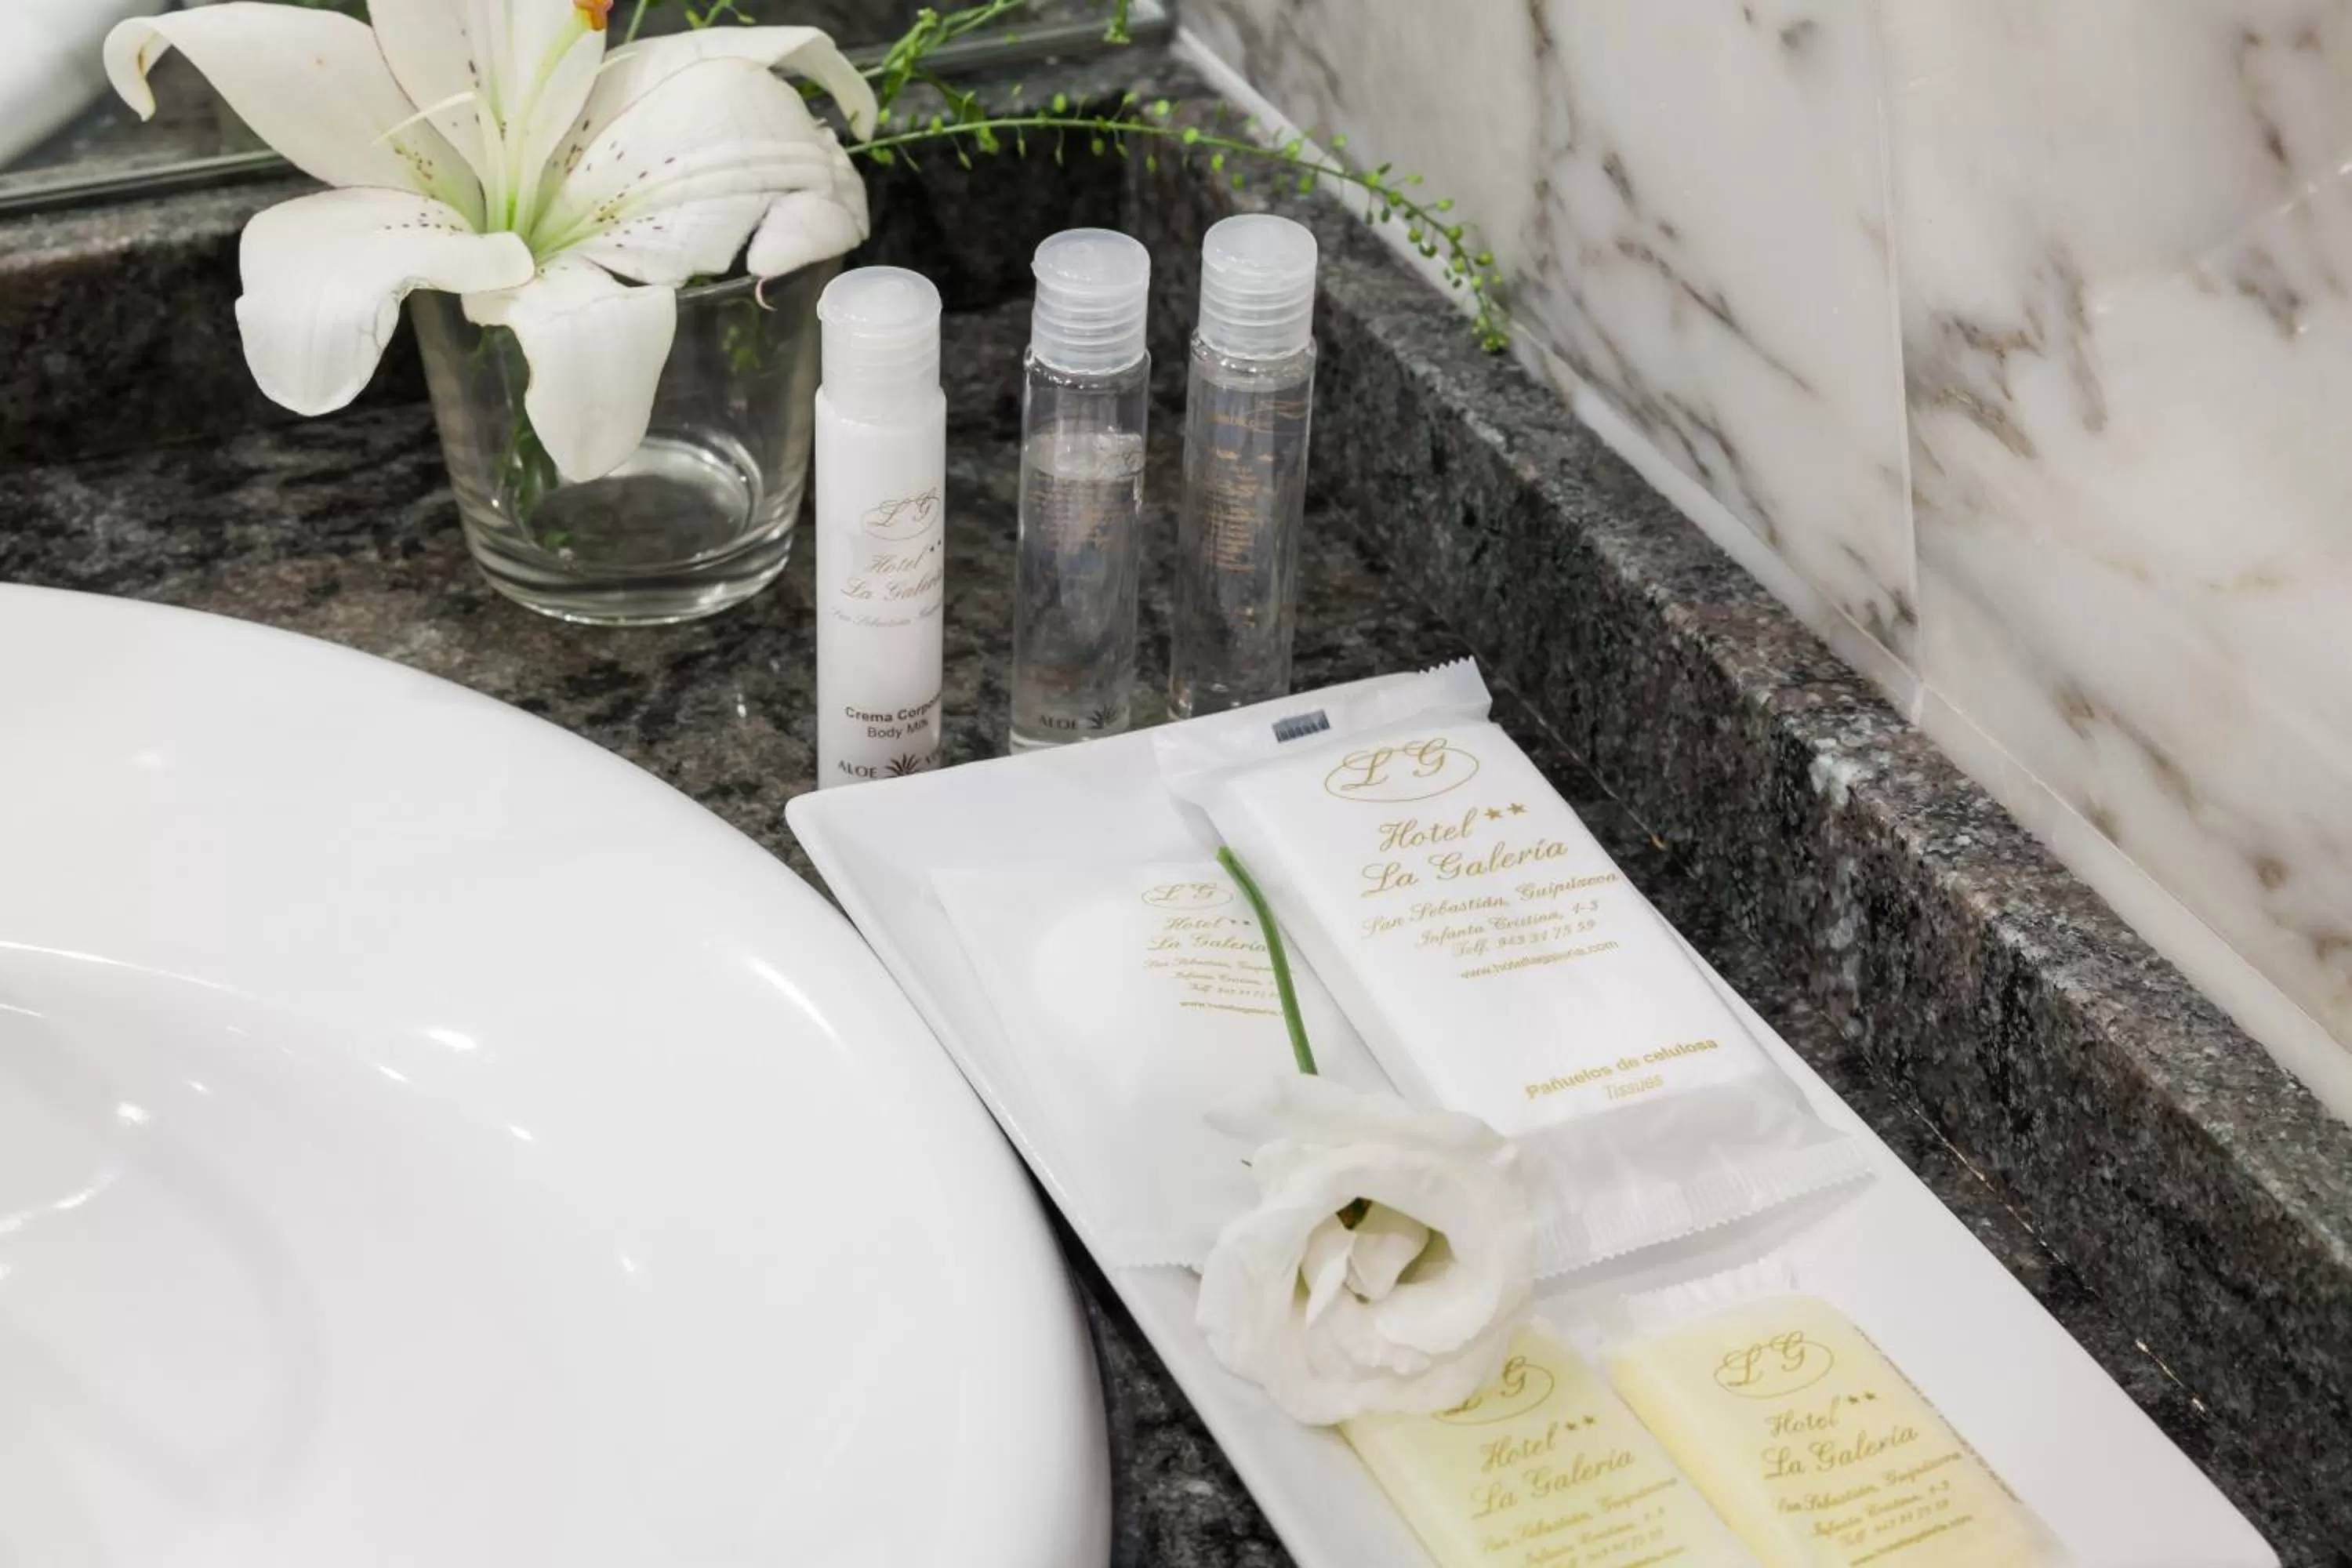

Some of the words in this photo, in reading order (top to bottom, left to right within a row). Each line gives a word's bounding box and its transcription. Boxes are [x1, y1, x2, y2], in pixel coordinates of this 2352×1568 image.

[844, 706, 894, 722] Crema
[1038, 714, 1079, 731] ALOE
[867, 726, 904, 740] Body
[838, 759, 878, 779] ALOE
[1378, 807, 1479, 853] Hotel
[1360, 862, 1420, 898] La
[1525, 1065, 1613, 1100] Pañuelos
[1616, 1058, 1641, 1073] de
[1642, 1037, 1719, 1064] celulosa
[1765, 1395, 1842, 1439] Hotel
[1479, 1421, 1559, 1475] Hotel
[1762, 1446, 1806, 1481] La
[1470, 1481, 1518, 1520] La
